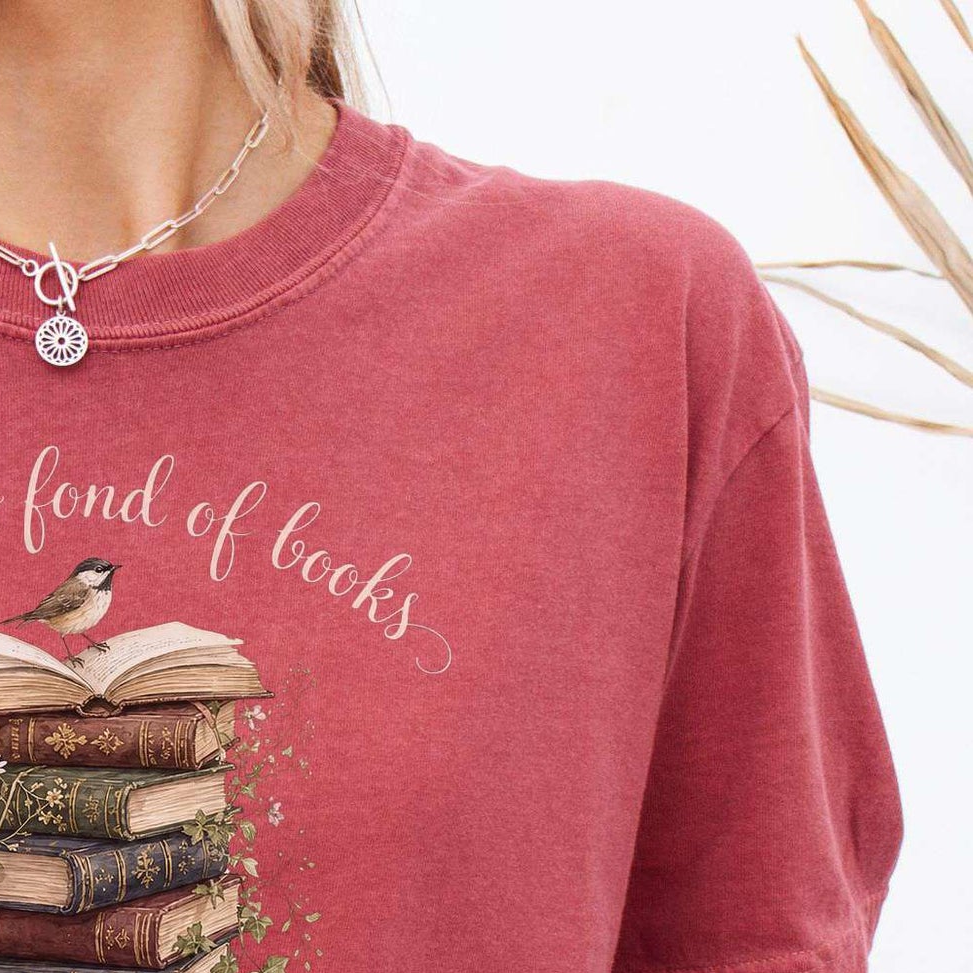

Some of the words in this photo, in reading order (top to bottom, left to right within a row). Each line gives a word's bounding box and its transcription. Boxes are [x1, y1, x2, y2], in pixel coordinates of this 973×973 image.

[24, 445, 175, 554] fond
[186, 481, 267, 582] of
[271, 501, 451, 674] books
